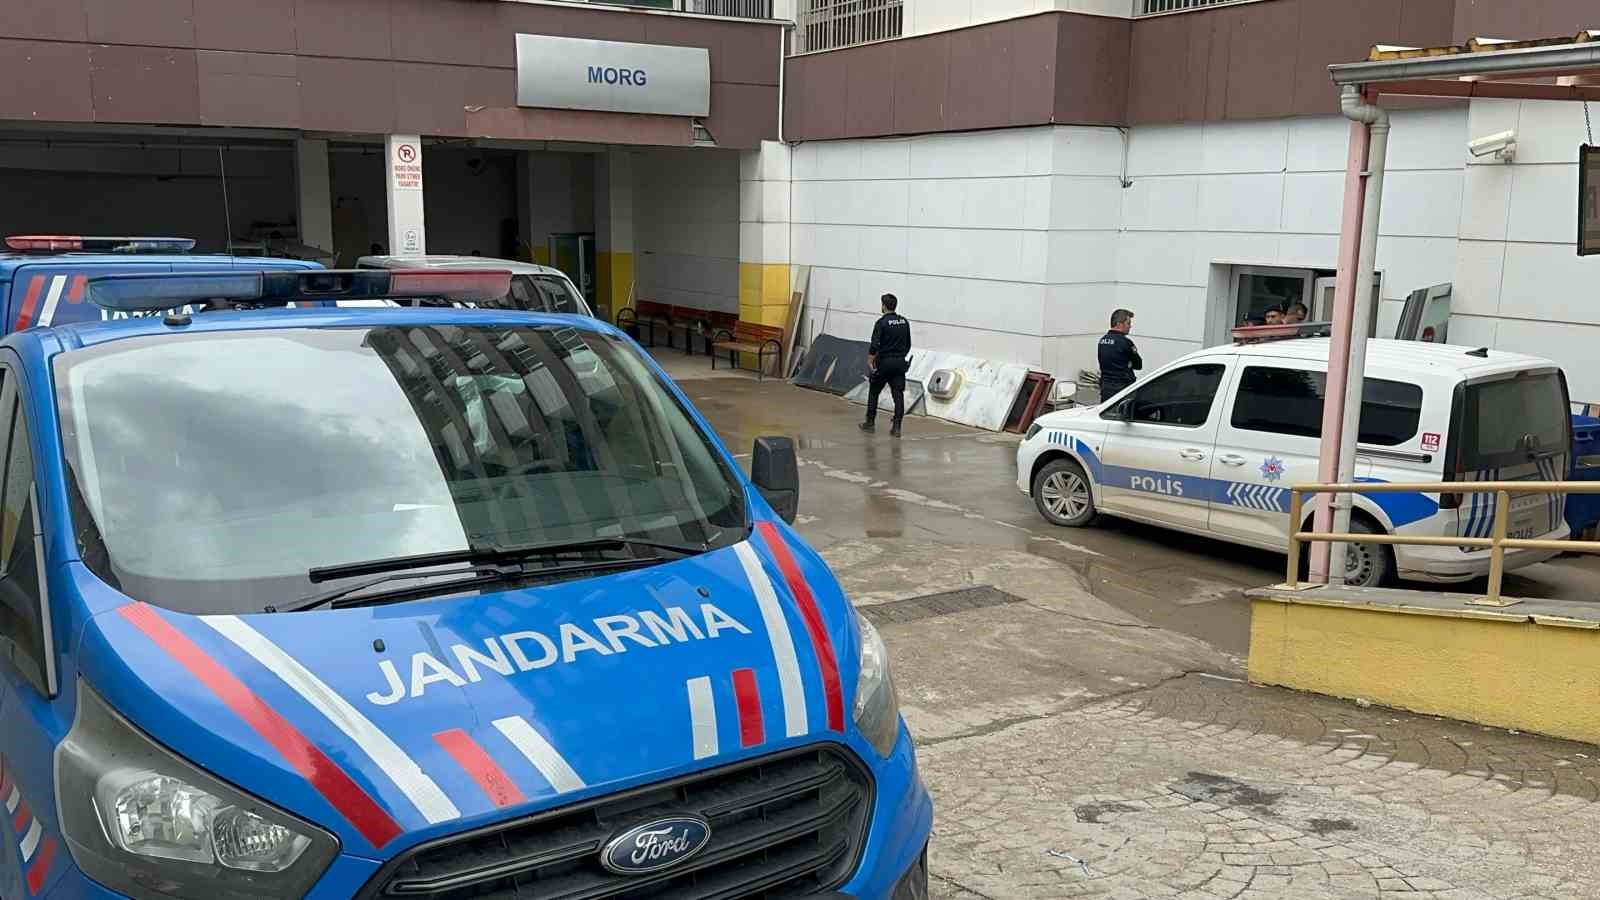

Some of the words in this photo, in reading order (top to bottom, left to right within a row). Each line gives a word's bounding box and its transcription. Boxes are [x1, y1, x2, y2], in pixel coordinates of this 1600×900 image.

[587, 65, 647, 87] MORG
[1424, 434, 1438, 445] 112
[1130, 475, 1184, 496] POLİS
[366, 603, 752, 706] JANDARMA
[631, 826, 690, 865] Ford
